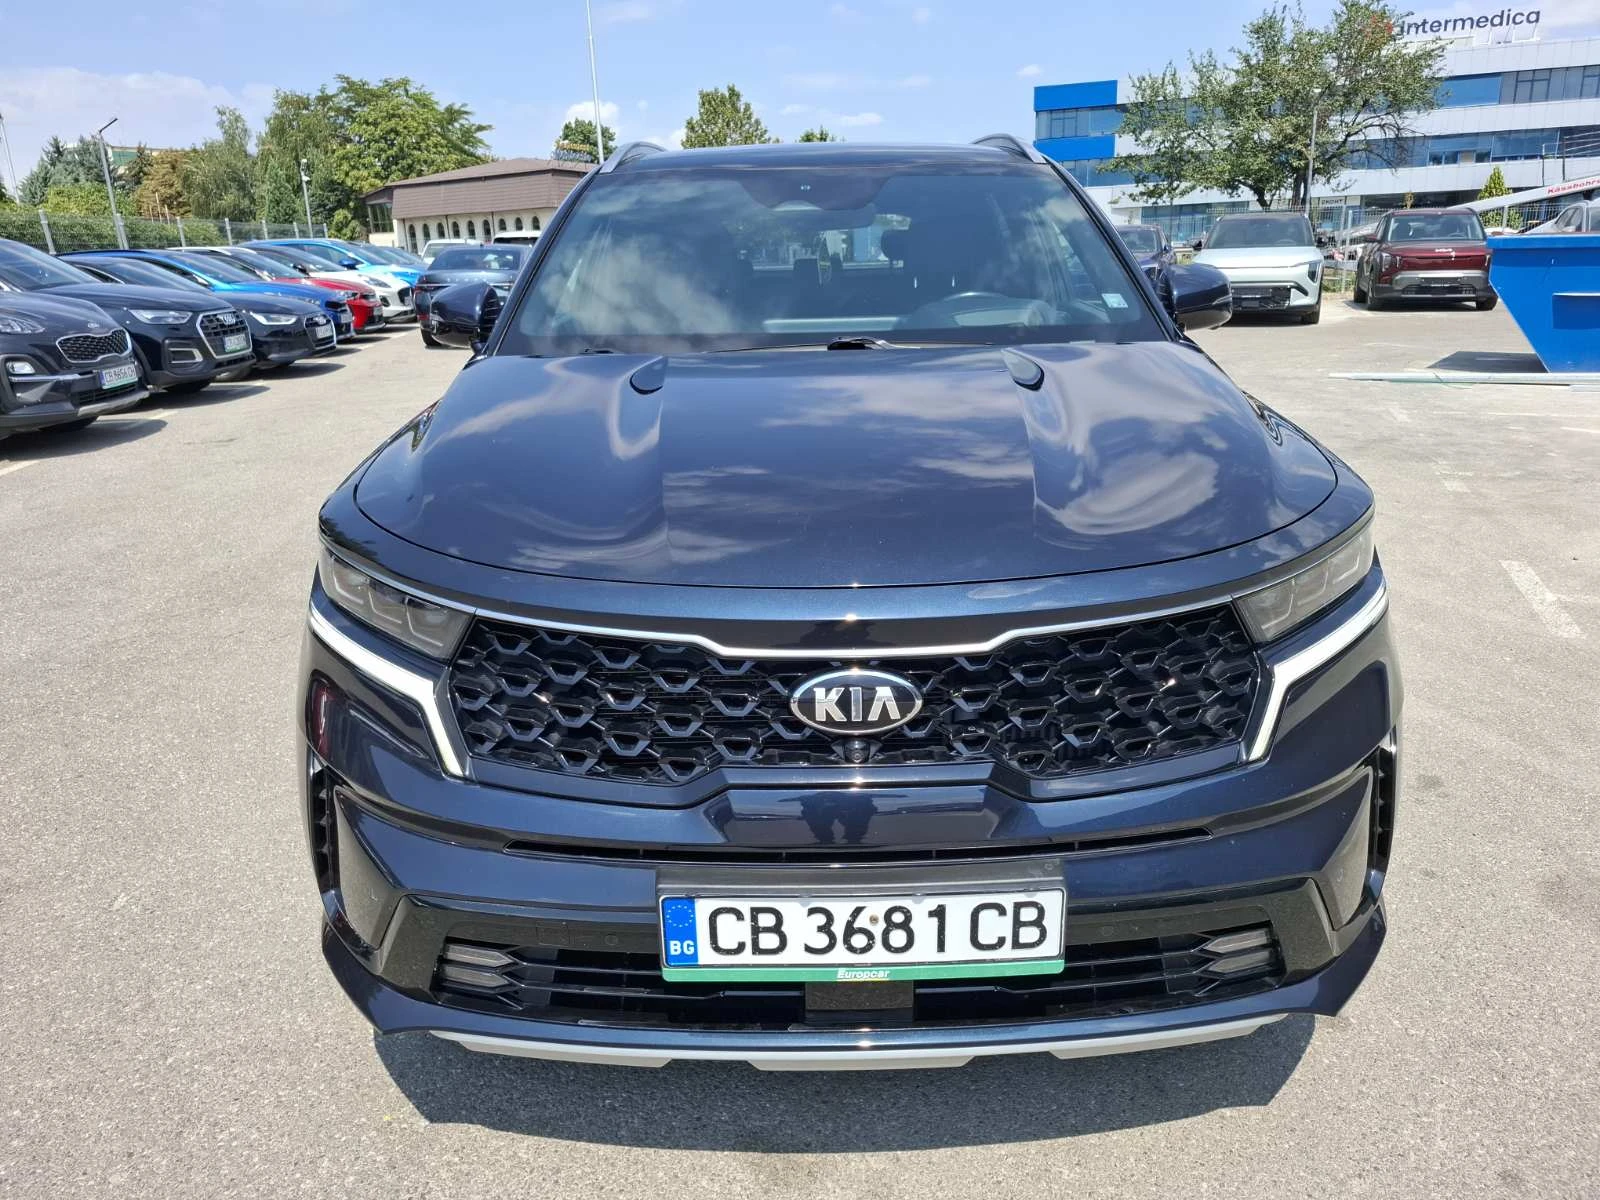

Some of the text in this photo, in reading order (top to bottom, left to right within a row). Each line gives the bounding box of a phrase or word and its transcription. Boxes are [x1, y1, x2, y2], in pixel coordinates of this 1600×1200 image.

[813, 686, 901, 722] KIA
[708, 900, 1048, 956] CB 3681 CB
[670, 940, 695, 956] BG
[837, 968, 890, 980] Europcar
